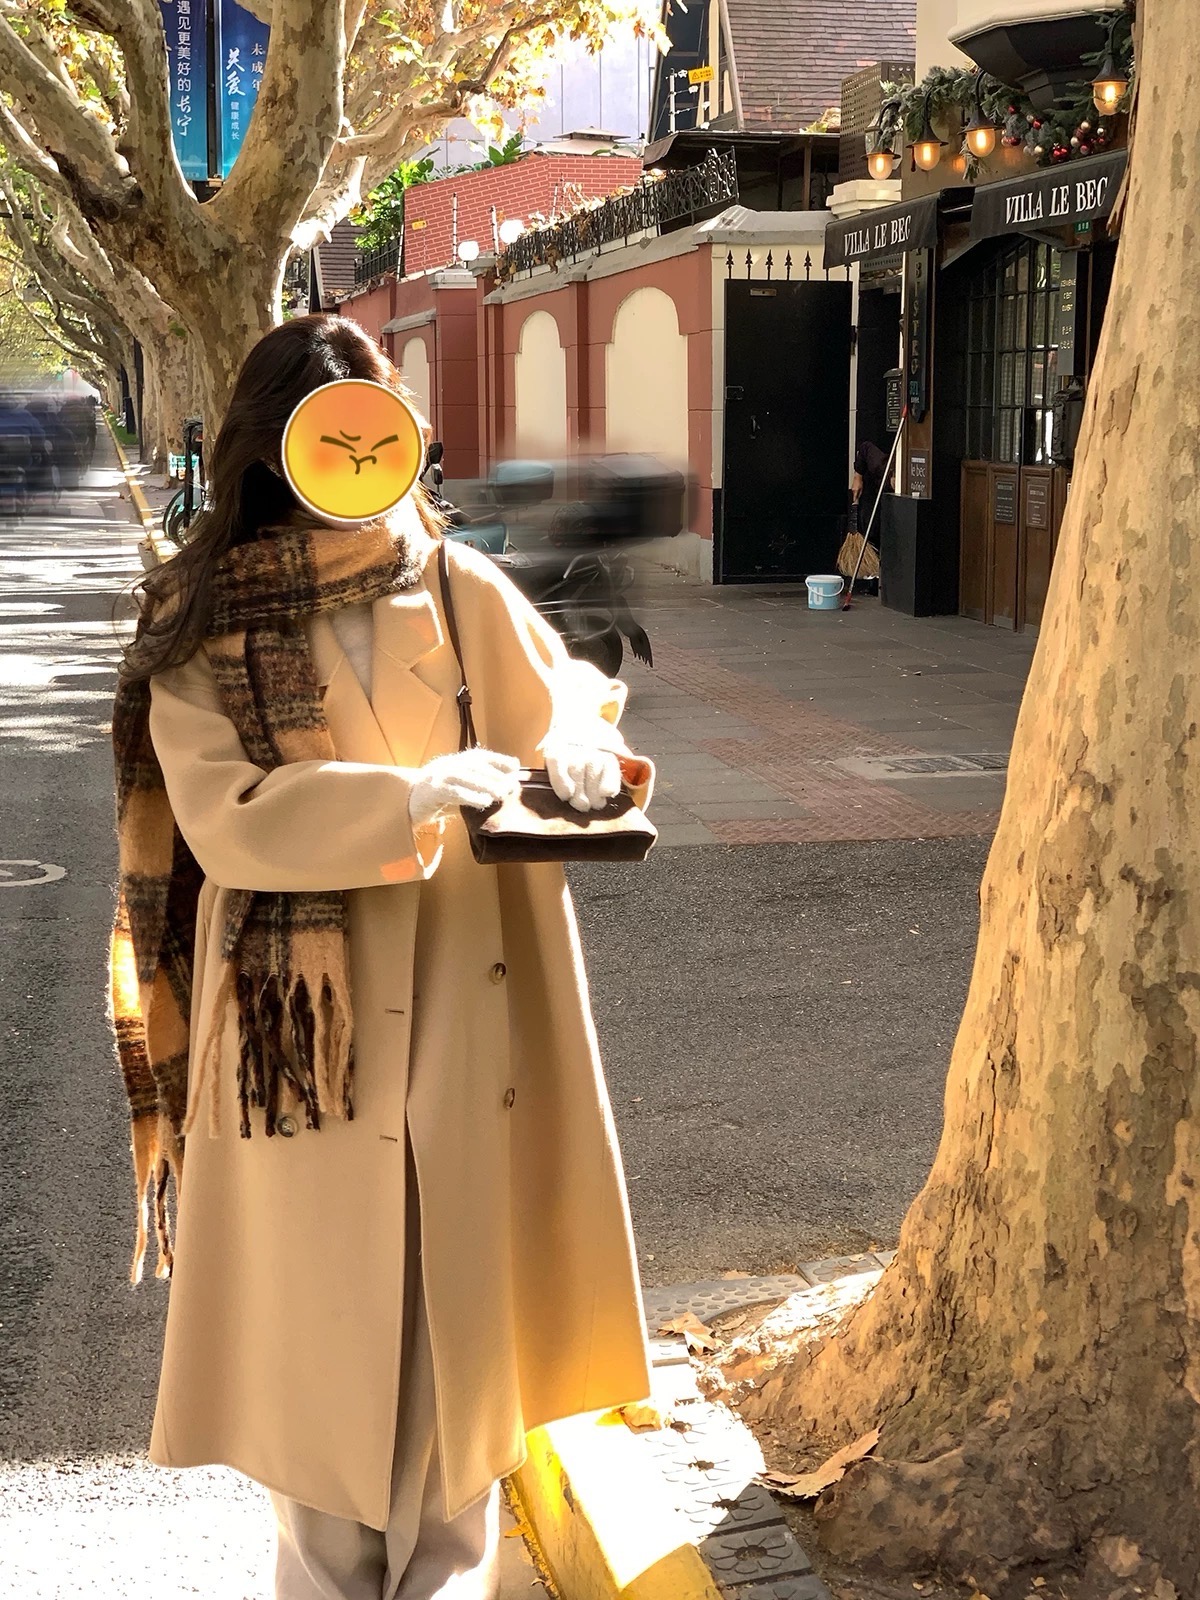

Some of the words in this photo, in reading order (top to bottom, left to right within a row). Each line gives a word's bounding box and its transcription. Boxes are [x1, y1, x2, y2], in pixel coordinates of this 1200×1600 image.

[177, 1, 192, 136] 遇见更美好的长宁
[225, 47, 246, 96] 关爱
[251, 43, 264, 109] 未成年
[1006, 190, 1043, 224] VILLA
[1049, 185, 1070, 216] LE
[1075, 176, 1108, 212] BEC
[844, 228, 870, 256] VILLA
[873, 222, 887, 249] LE
[890, 215, 911, 244] BEC
